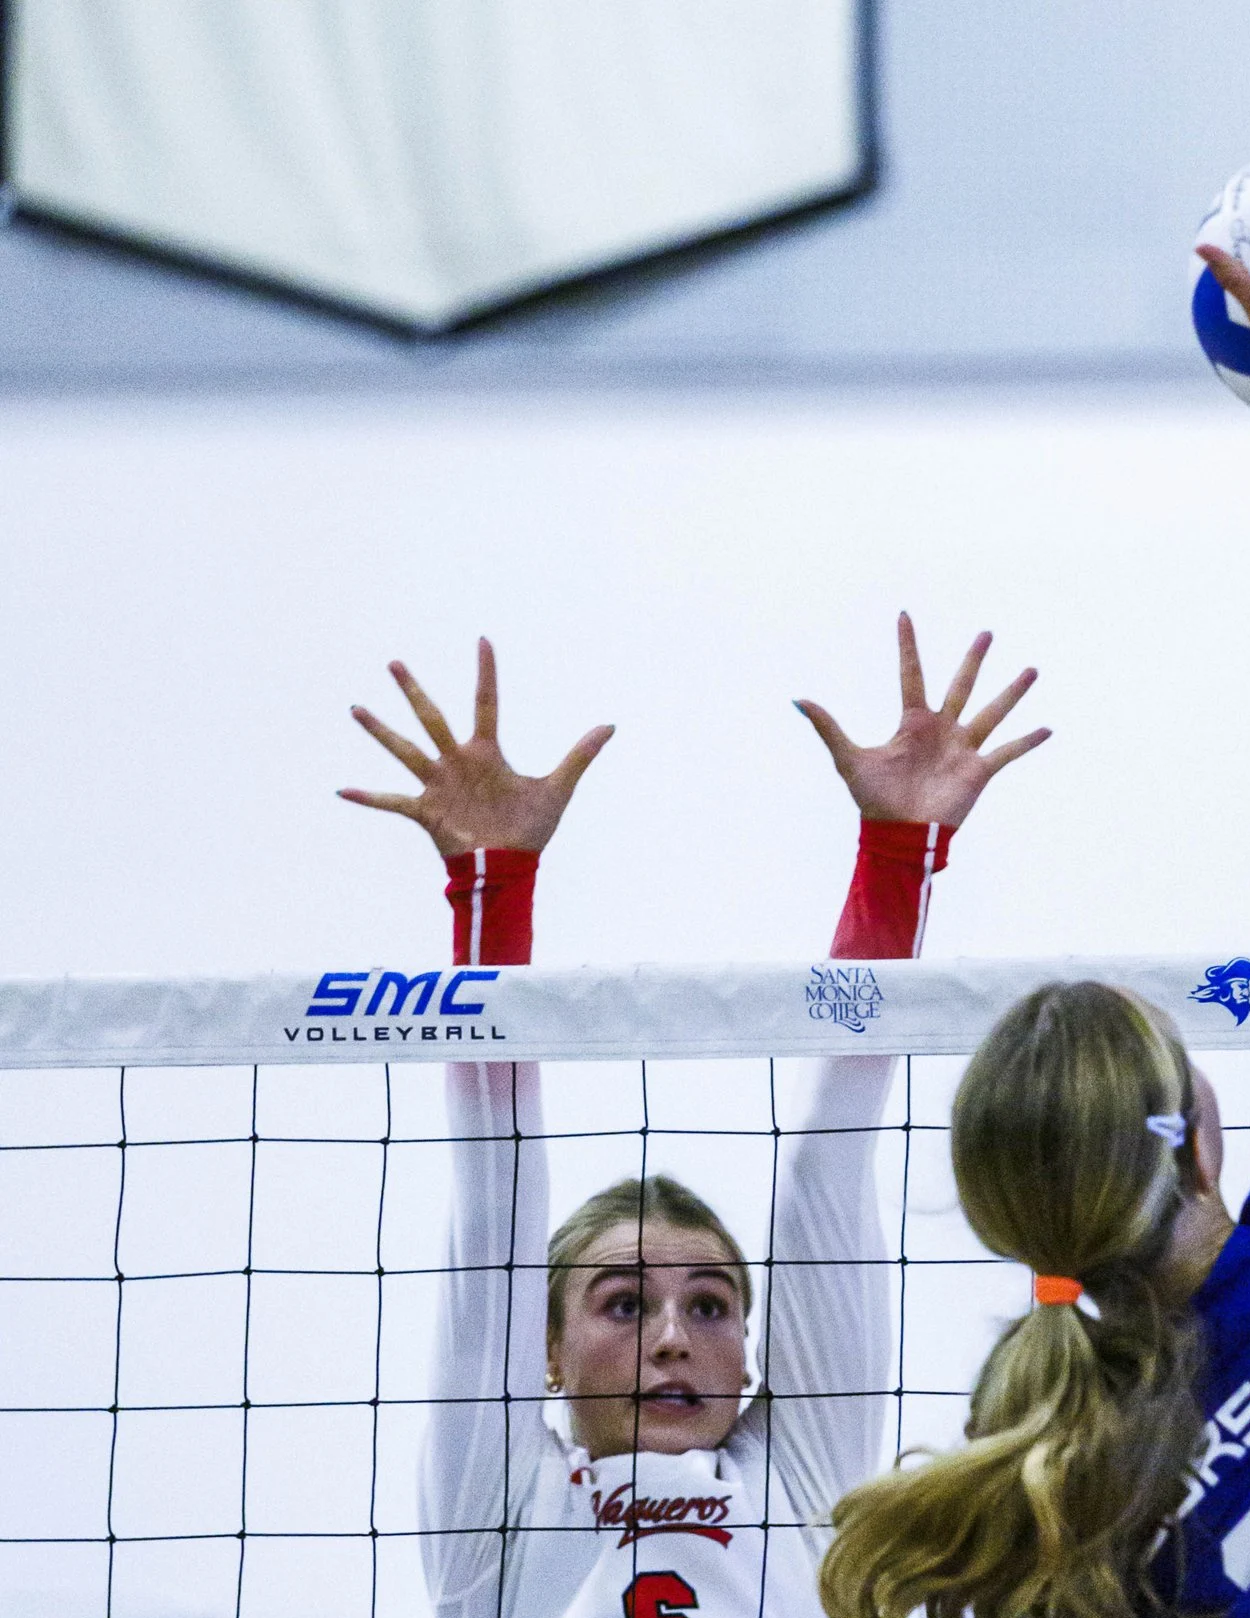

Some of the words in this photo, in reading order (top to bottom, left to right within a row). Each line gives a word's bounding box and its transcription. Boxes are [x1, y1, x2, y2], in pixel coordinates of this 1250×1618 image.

[811, 964, 877, 984] SANTA
[305, 970, 501, 1016] SMC
[805, 984, 884, 1001] MONICA
[808, 1001, 881, 1033] COLLEGE
[284, 1026, 506, 1041] VOLLEYBALL
[592, 1482, 733, 1549] Vaqueros
